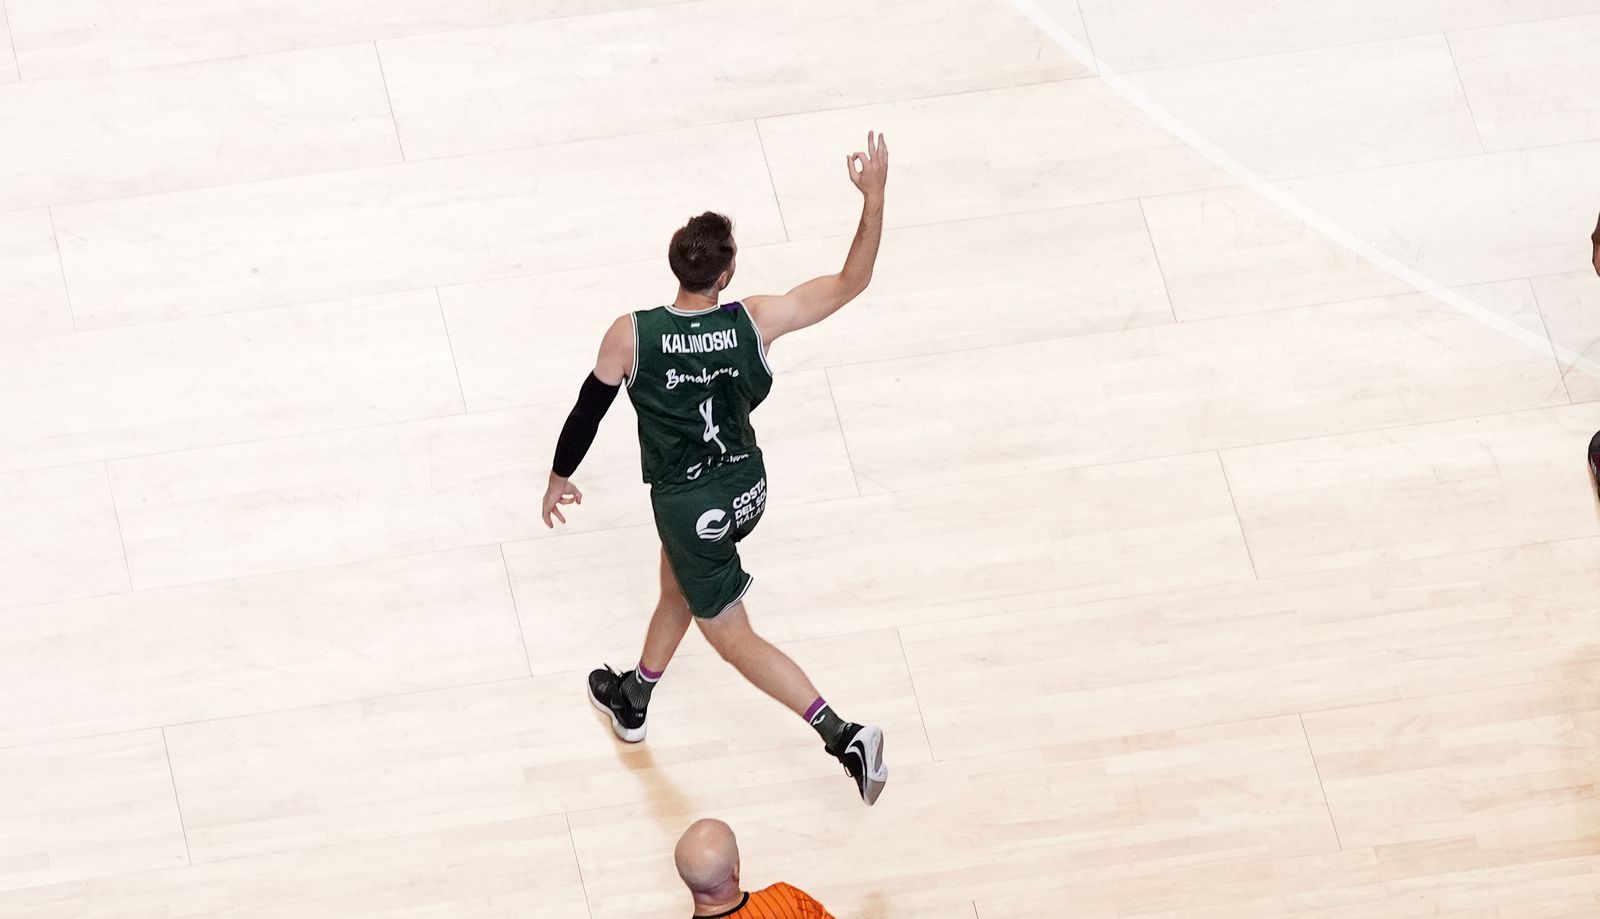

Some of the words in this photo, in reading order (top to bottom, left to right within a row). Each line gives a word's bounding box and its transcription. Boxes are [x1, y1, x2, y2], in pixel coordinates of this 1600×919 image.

[662, 328, 738, 353] KALINOSKI
[699, 396, 726, 454] 4
[732, 478, 765, 510] COSTA
[735, 503, 756, 520] DEL
